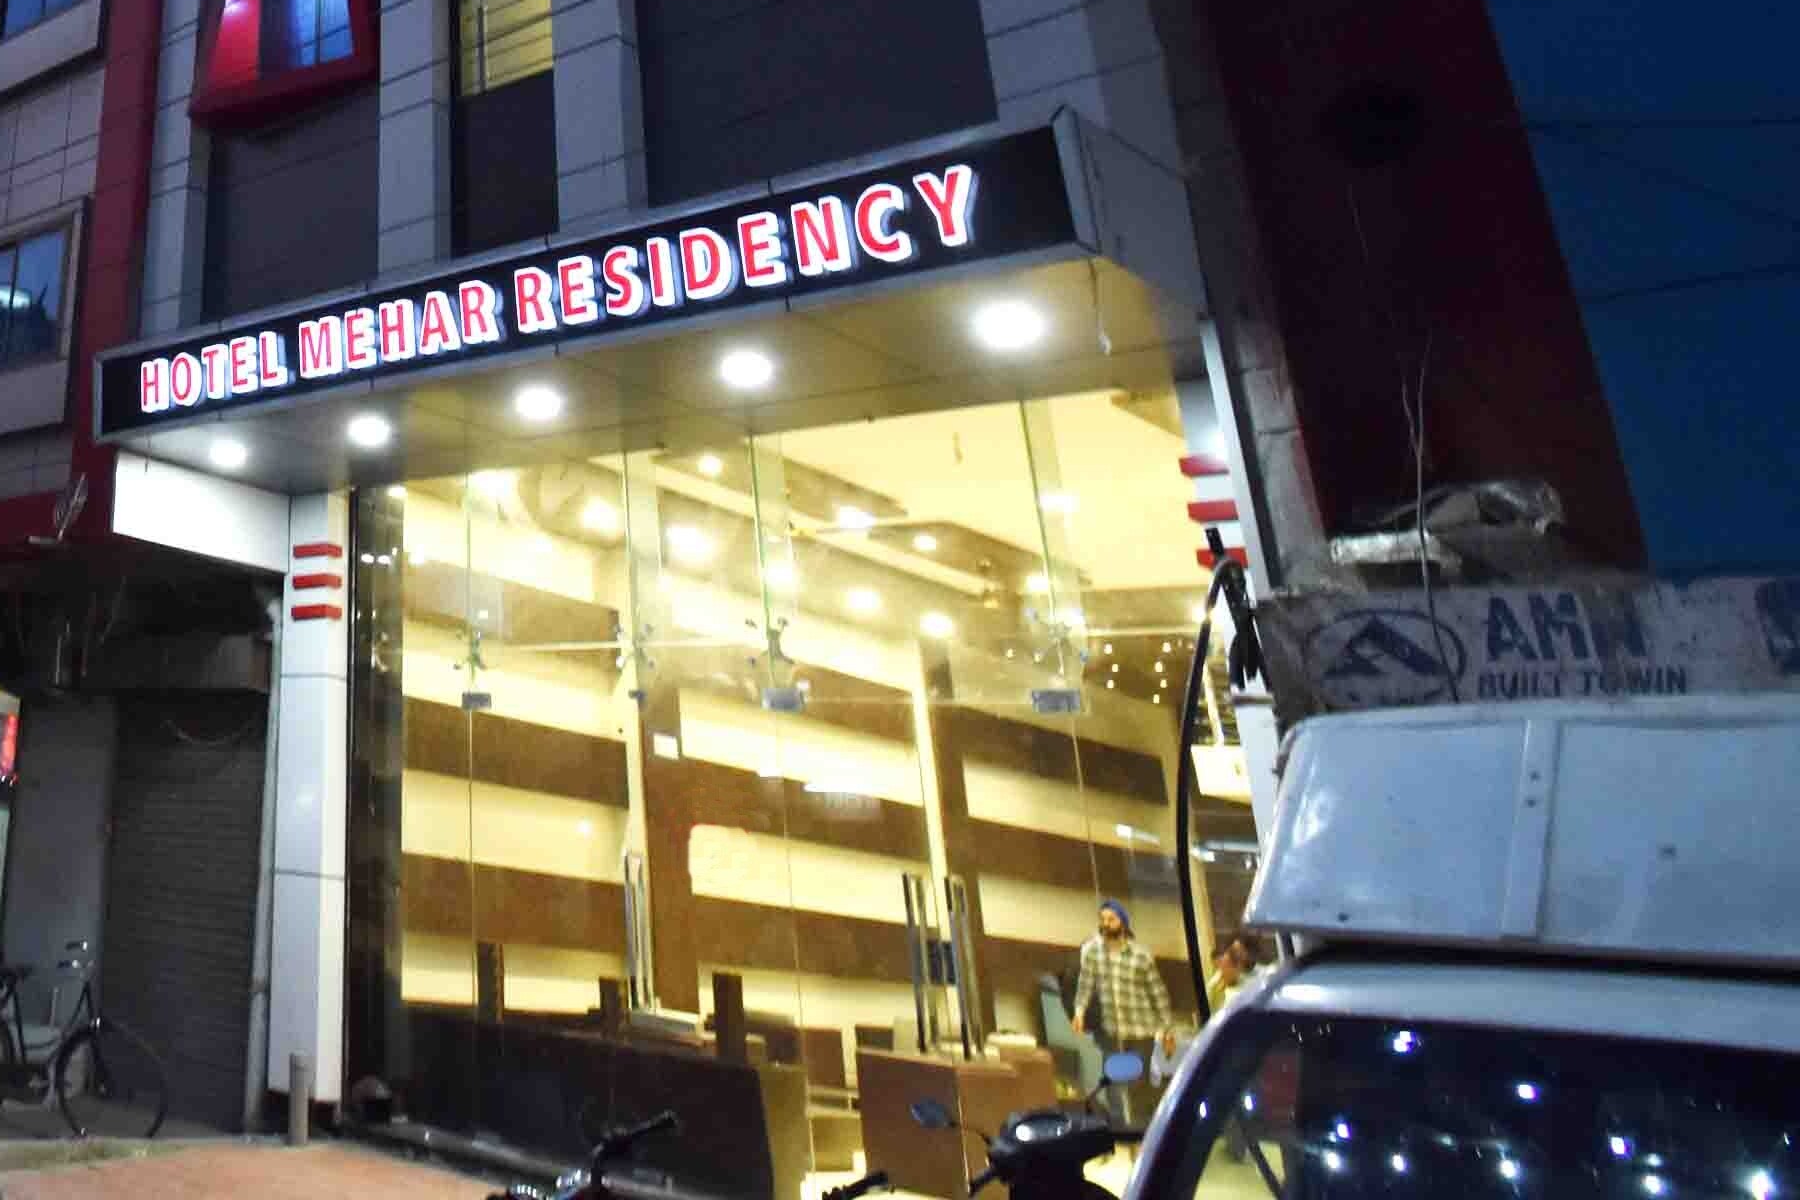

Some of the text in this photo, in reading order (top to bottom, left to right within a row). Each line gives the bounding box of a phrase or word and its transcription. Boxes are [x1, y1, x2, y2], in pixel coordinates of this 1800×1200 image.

[140, 164, 975, 413] HOTEL MEHAR RESIDENCY
